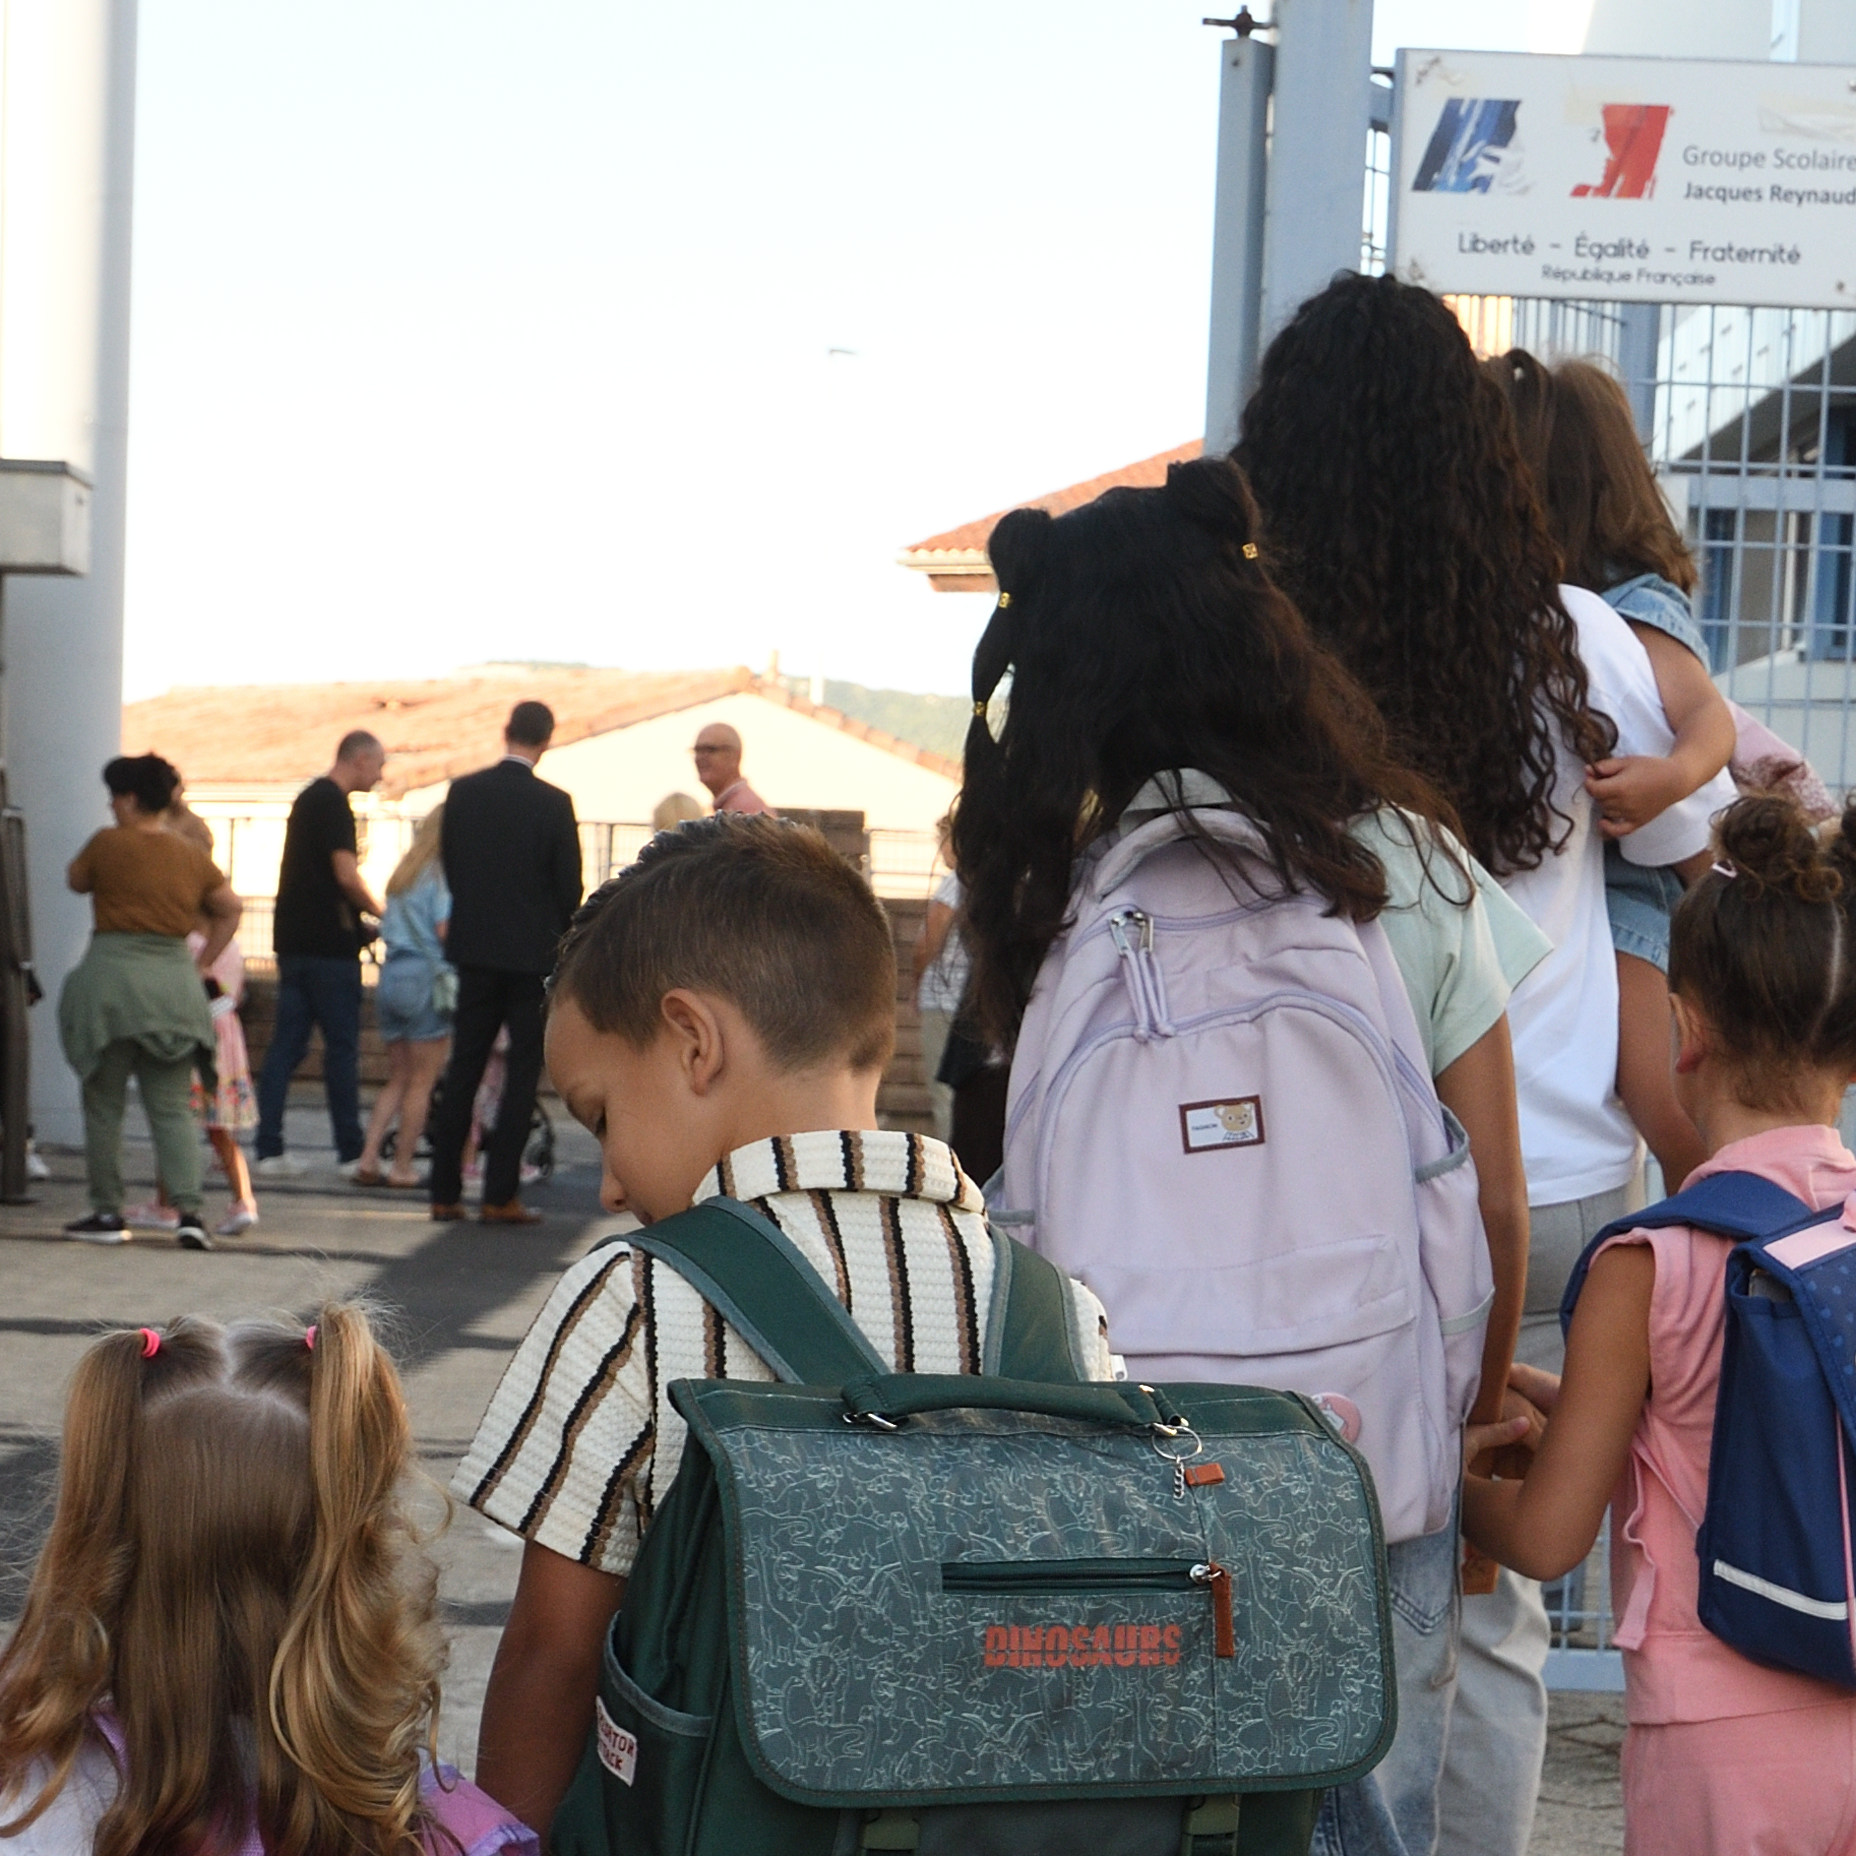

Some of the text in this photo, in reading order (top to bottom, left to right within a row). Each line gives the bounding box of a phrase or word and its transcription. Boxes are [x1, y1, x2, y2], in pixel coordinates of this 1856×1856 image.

[1682, 144, 1766, 171] Groupe
[1684, 182, 1856, 207] Jacques Reynaud
[1458, 231, 1536, 255] Liberté
[1574, 230, 1650, 262] Égalité
[1689, 240, 1802, 265] Fraternité
[1542, 264, 1716, 286] République Française
[983, 1624, 1182, 1667] DINOSAURS
